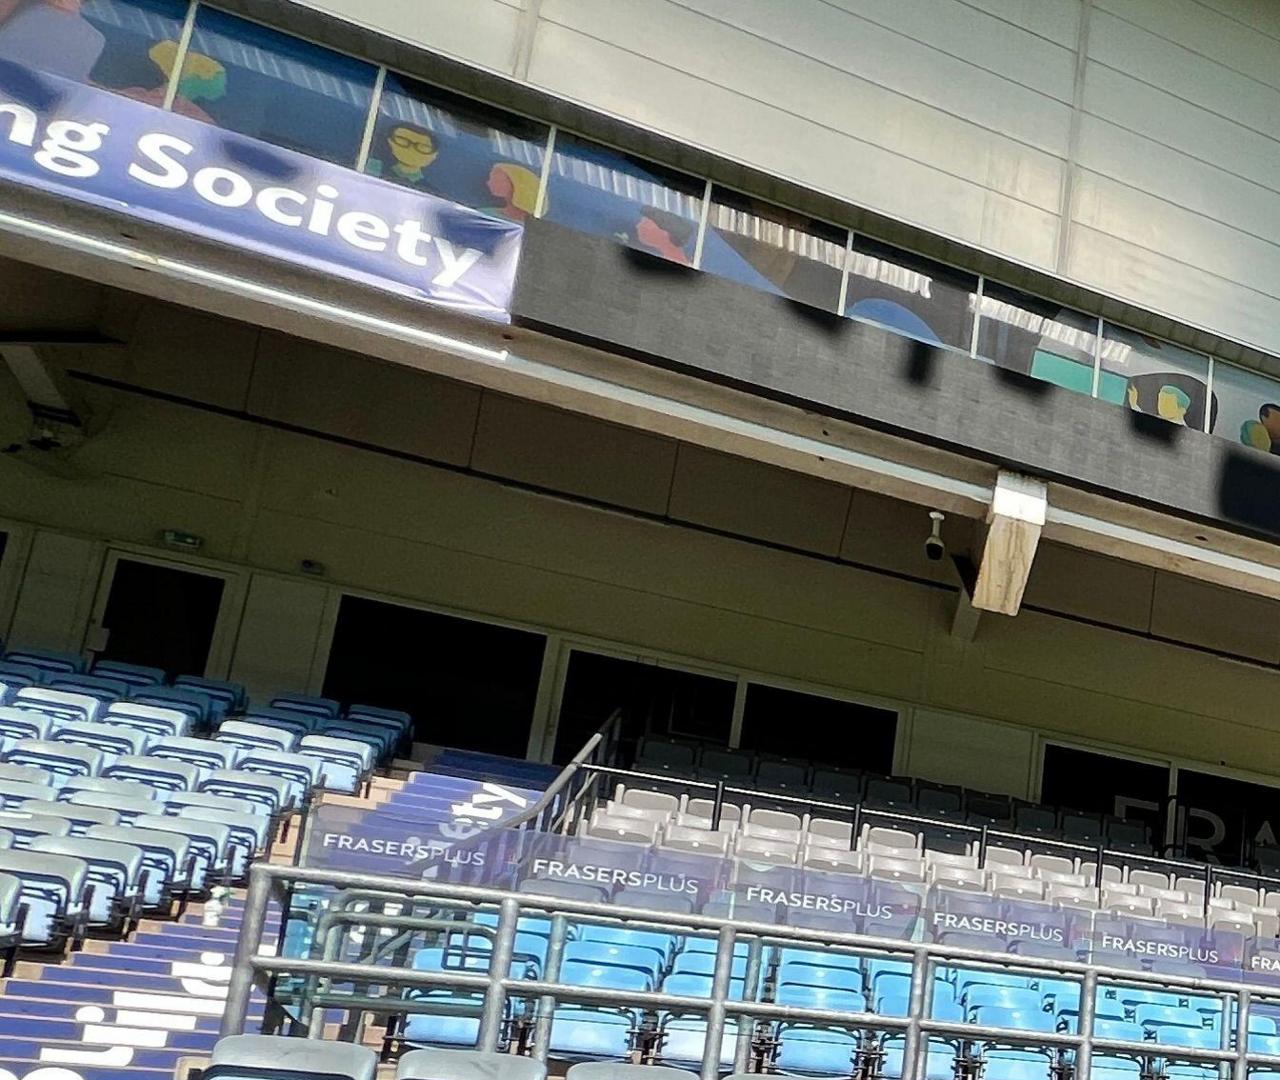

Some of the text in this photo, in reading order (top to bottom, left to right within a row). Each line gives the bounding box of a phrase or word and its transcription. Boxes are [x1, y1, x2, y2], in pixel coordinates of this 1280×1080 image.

[128, 132, 484, 289] Society
[322, 834, 485, 868] FRASERSPLUS
[533, 859, 699, 895] FRASERSPLUS
[746, 886, 892, 920] FRASERSPLUS
[934, 912, 1064, 942] FRASERSPLUS
[1102, 935, 1219, 964] FRASERSPLUS
